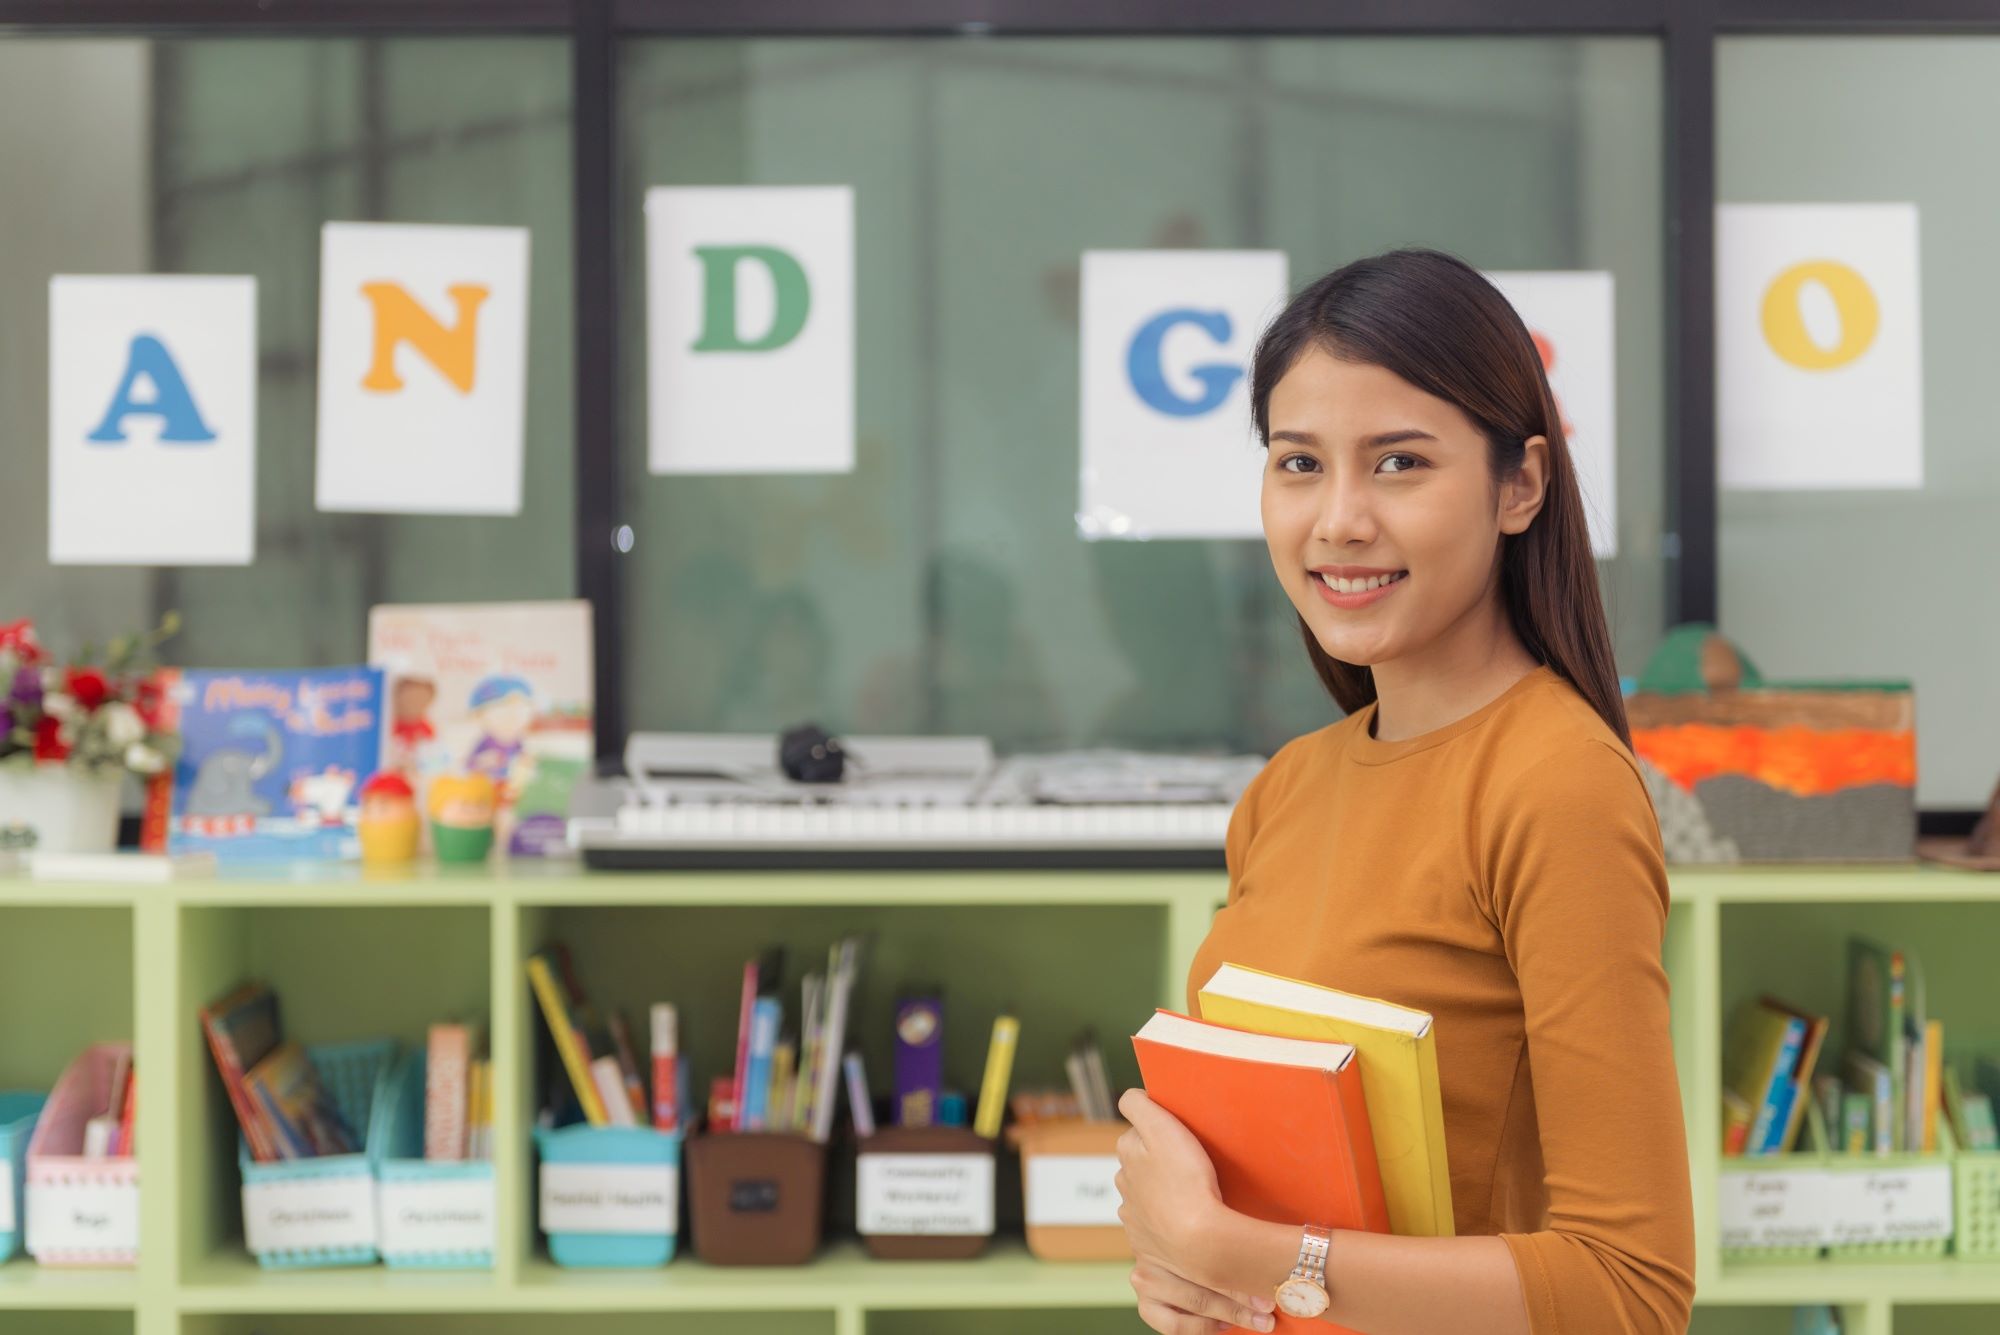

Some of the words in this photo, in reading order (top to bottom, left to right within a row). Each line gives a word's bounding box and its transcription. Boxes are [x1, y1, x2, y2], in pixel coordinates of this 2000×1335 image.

[360, 281, 490, 395] N
[690, 245, 811, 351] D
[1760, 260, 1881, 372] O
[86, 334, 218, 444] A
[1125, 308, 1245, 418] G
